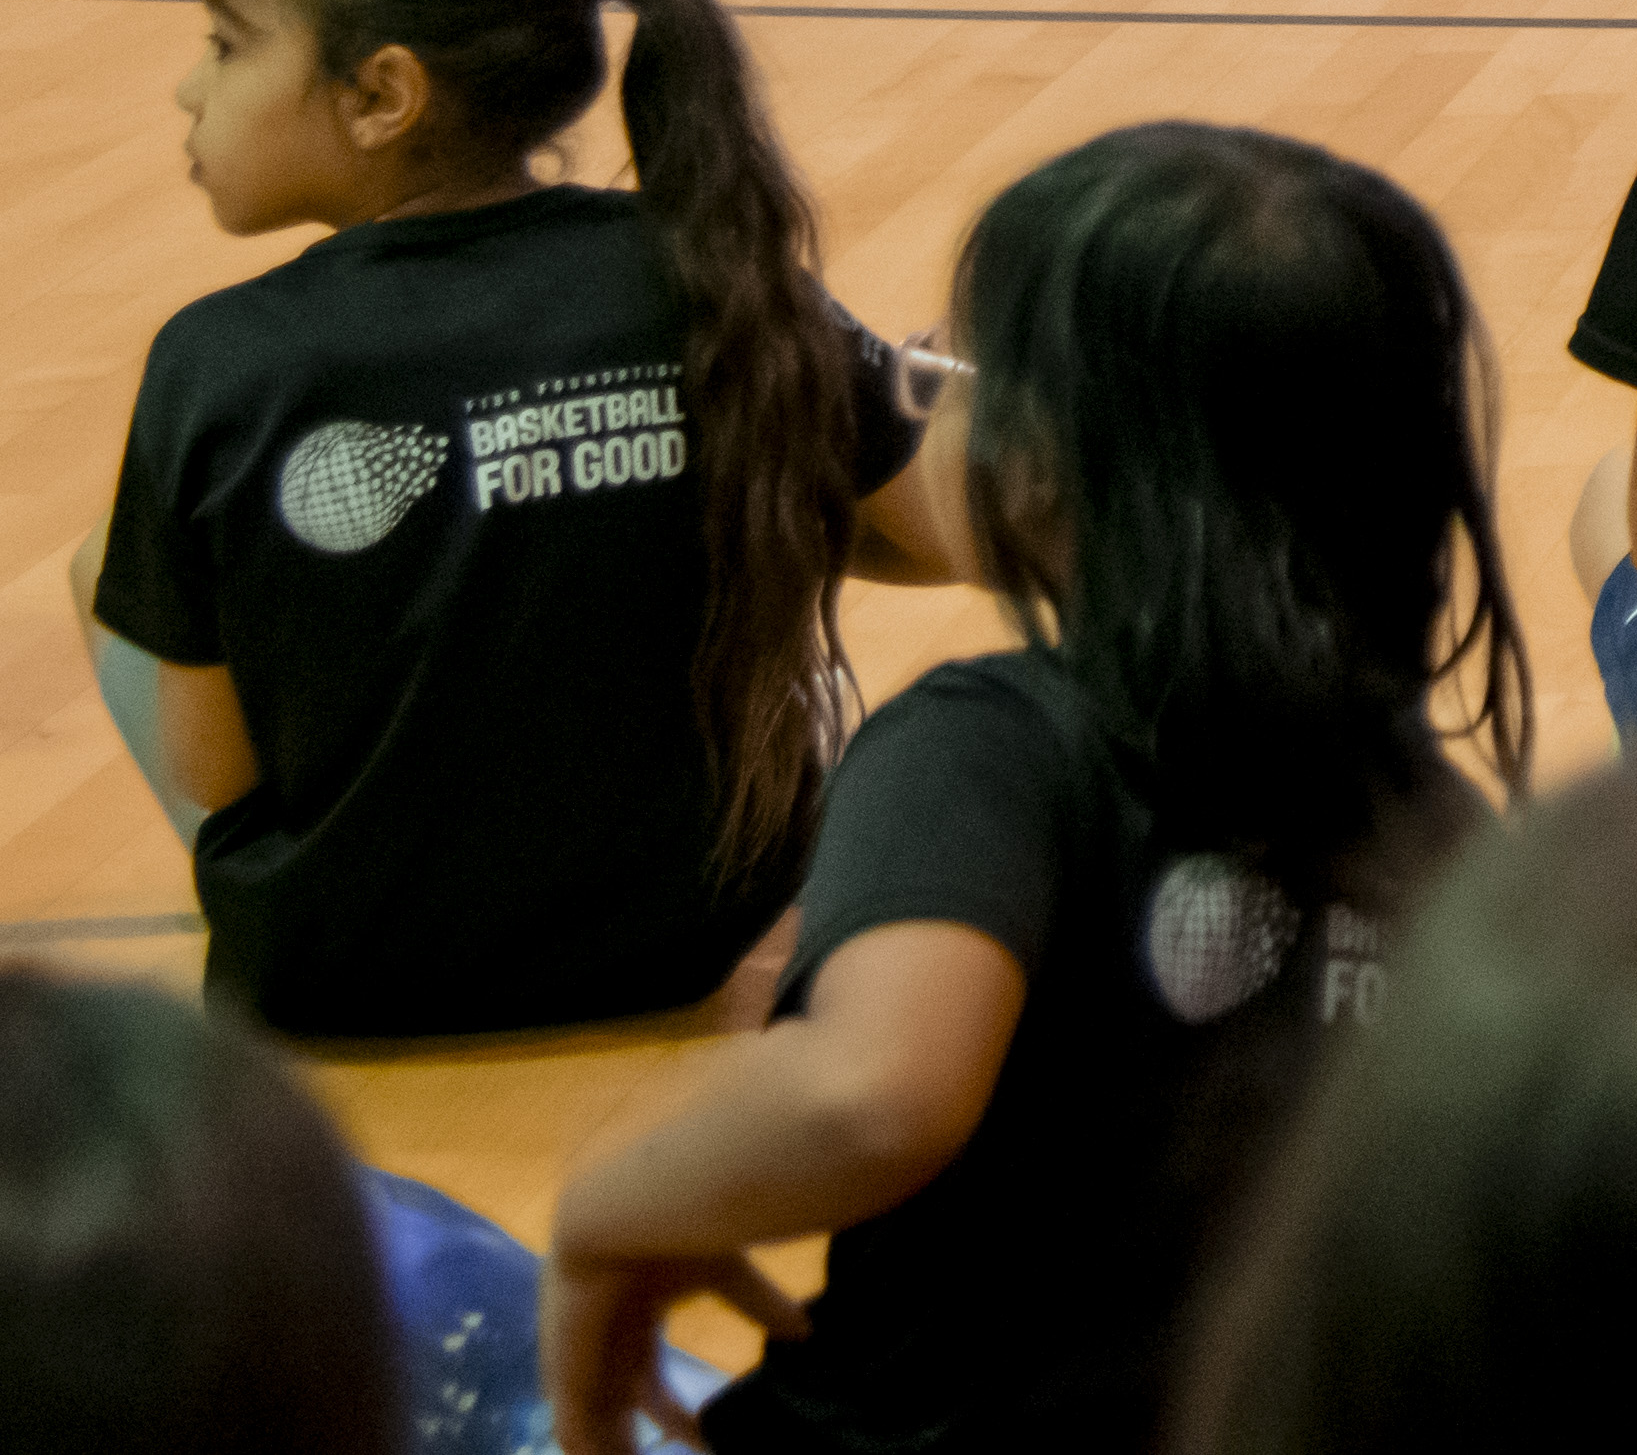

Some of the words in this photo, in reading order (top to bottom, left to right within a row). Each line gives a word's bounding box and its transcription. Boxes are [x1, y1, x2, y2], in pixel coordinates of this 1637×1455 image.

[469, 387, 686, 459] BASKETBALL
[474, 448, 563, 513] FOR
[573, 429, 687, 493] GOOD
